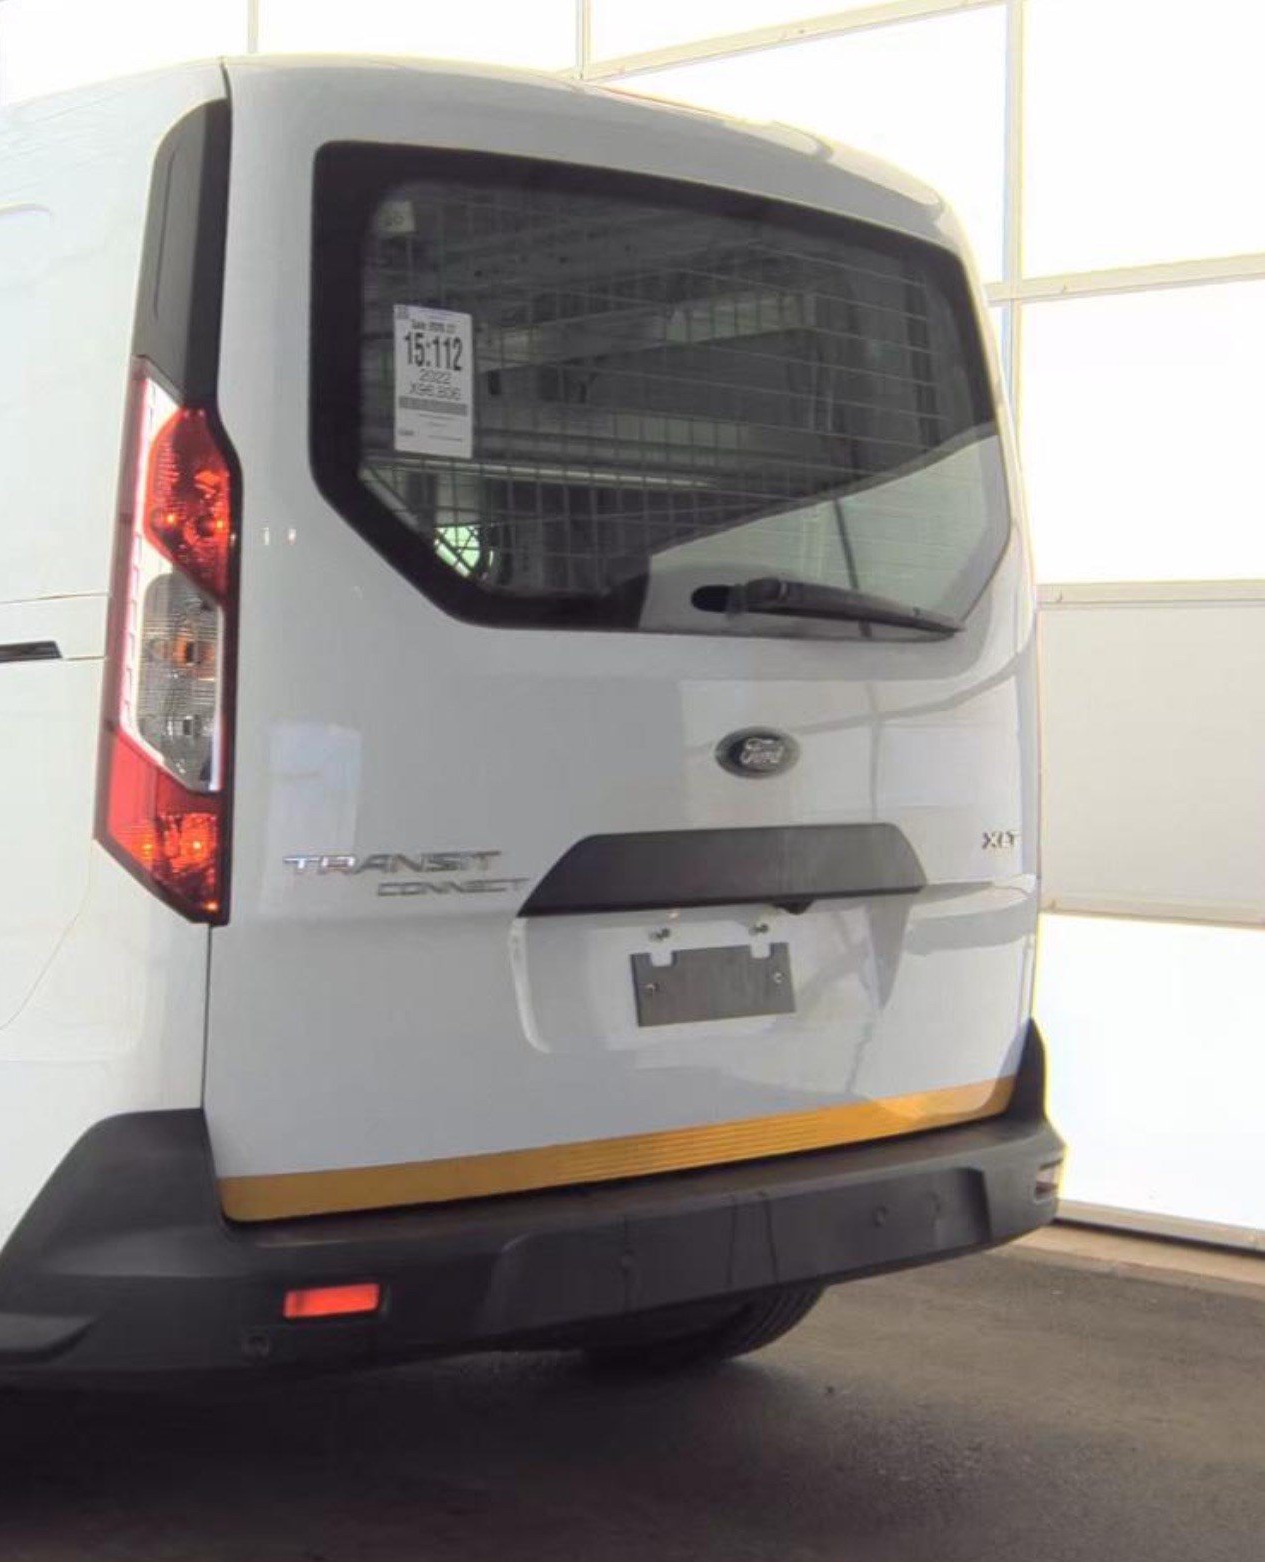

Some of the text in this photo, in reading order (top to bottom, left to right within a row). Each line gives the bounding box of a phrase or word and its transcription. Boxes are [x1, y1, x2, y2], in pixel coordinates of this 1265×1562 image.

[404, 331, 463, 371] 15:112
[981, 830, 1021, 849] XLT
[282, 850, 503, 876] TRANSIT
[377, 877, 530, 897] CONNECT
